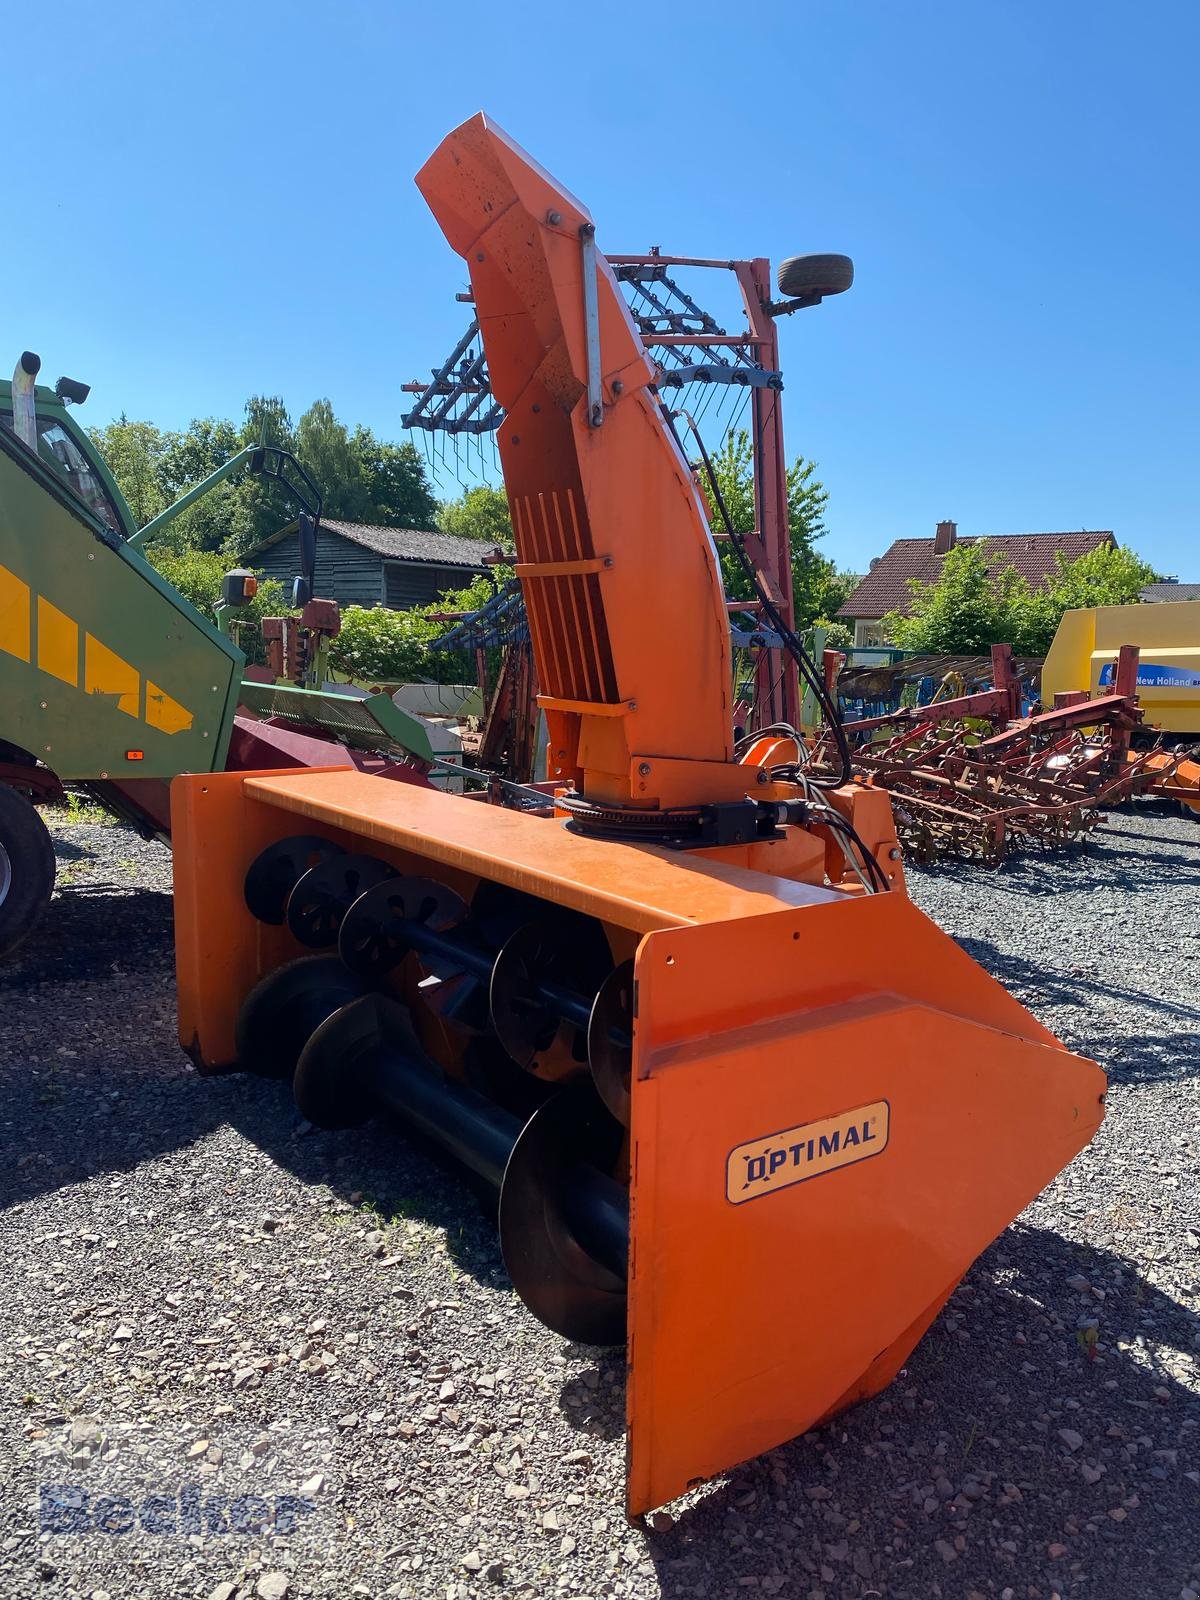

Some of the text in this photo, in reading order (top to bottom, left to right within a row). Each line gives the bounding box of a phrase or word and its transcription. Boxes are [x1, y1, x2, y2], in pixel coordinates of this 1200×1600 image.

[1136, 676, 1155, 685] New
[1157, 676, 1191, 687] Holland
[742, 1119, 876, 1190] OPTIMAL
